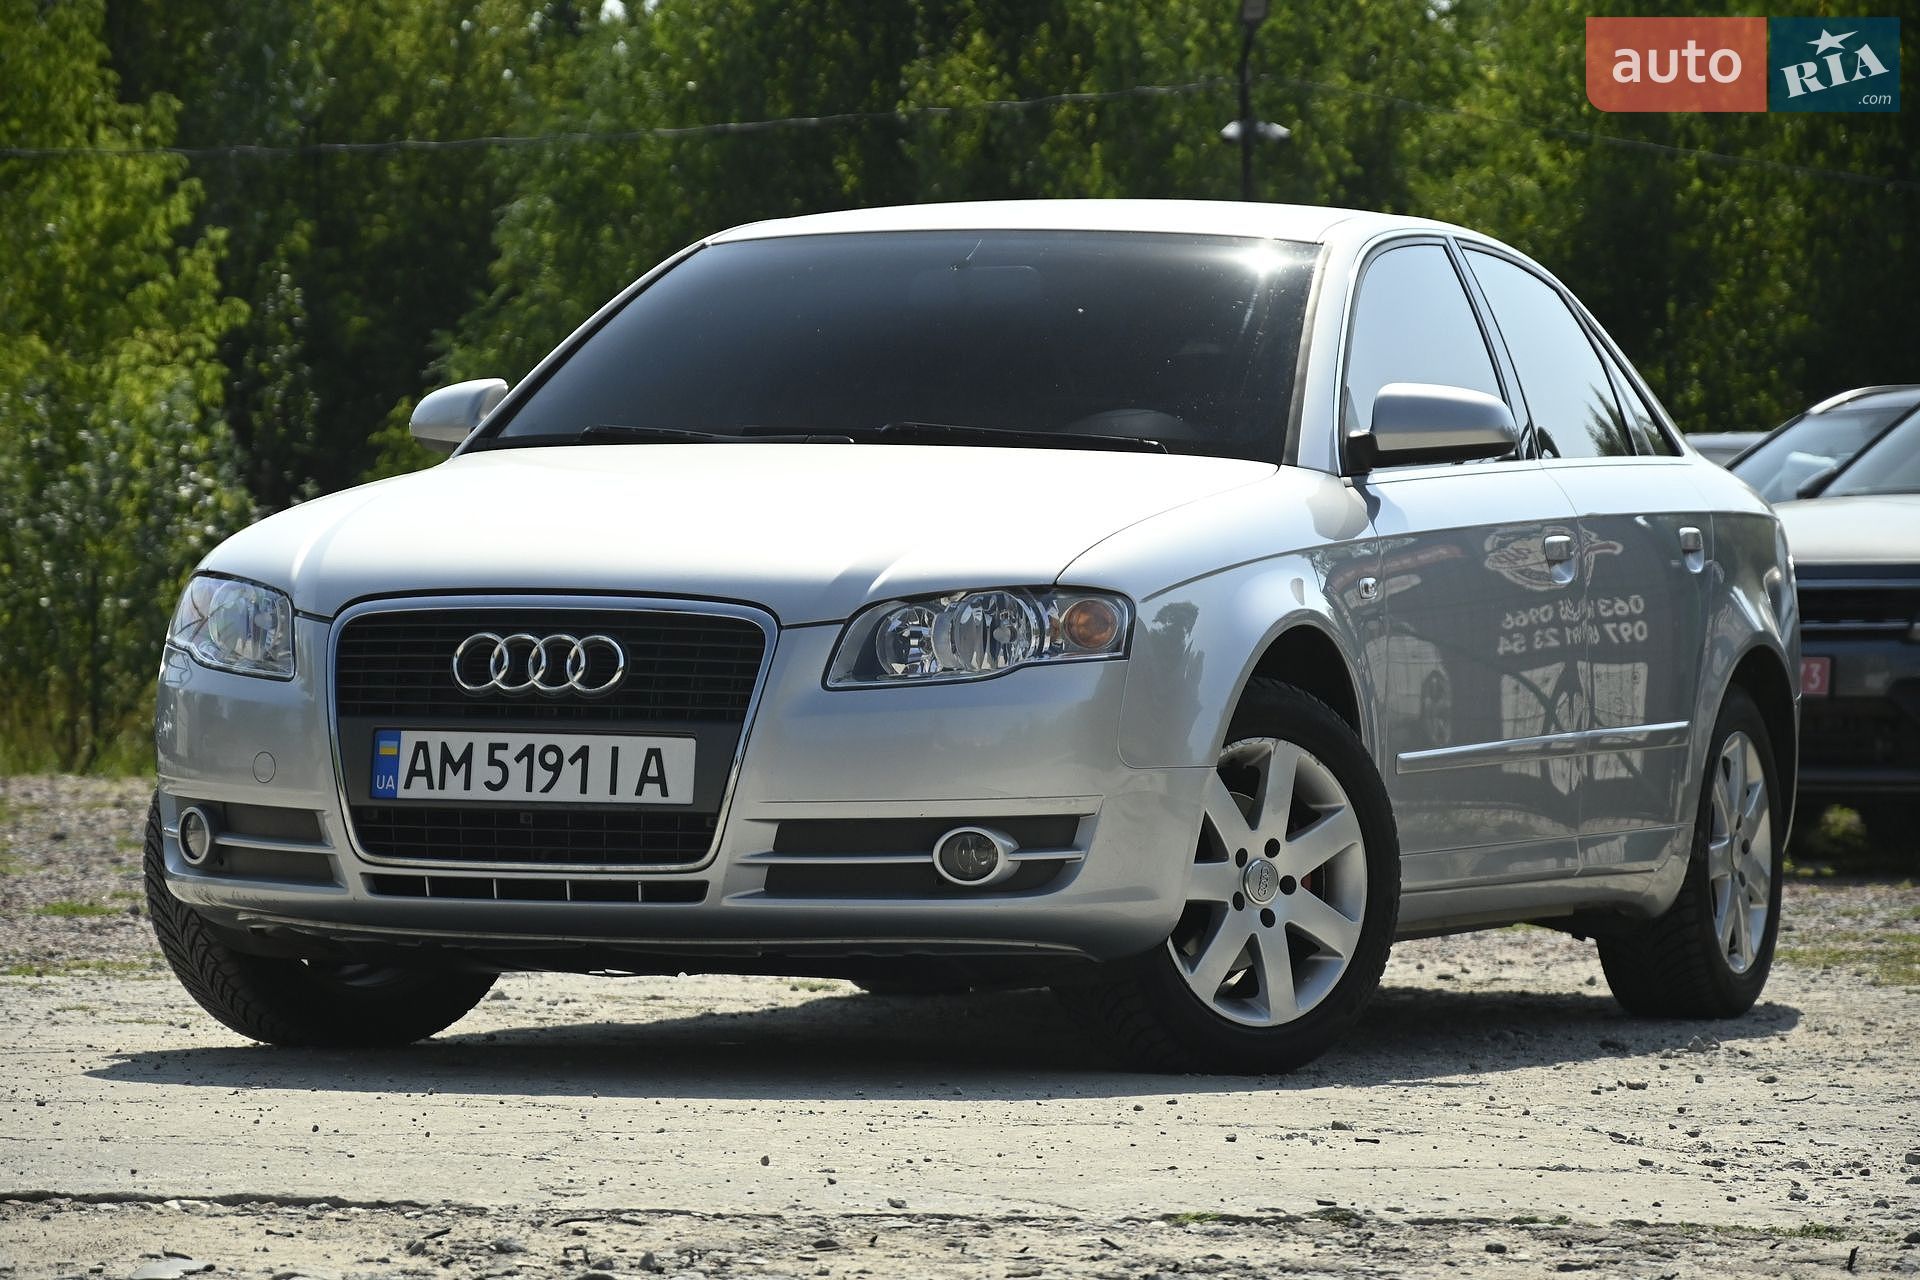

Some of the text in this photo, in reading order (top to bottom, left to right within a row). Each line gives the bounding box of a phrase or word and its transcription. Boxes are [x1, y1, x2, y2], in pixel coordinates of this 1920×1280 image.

[376, 774, 395, 791] UA
[403, 740, 475, 792] AM
[483, 742, 591, 796] 5191
